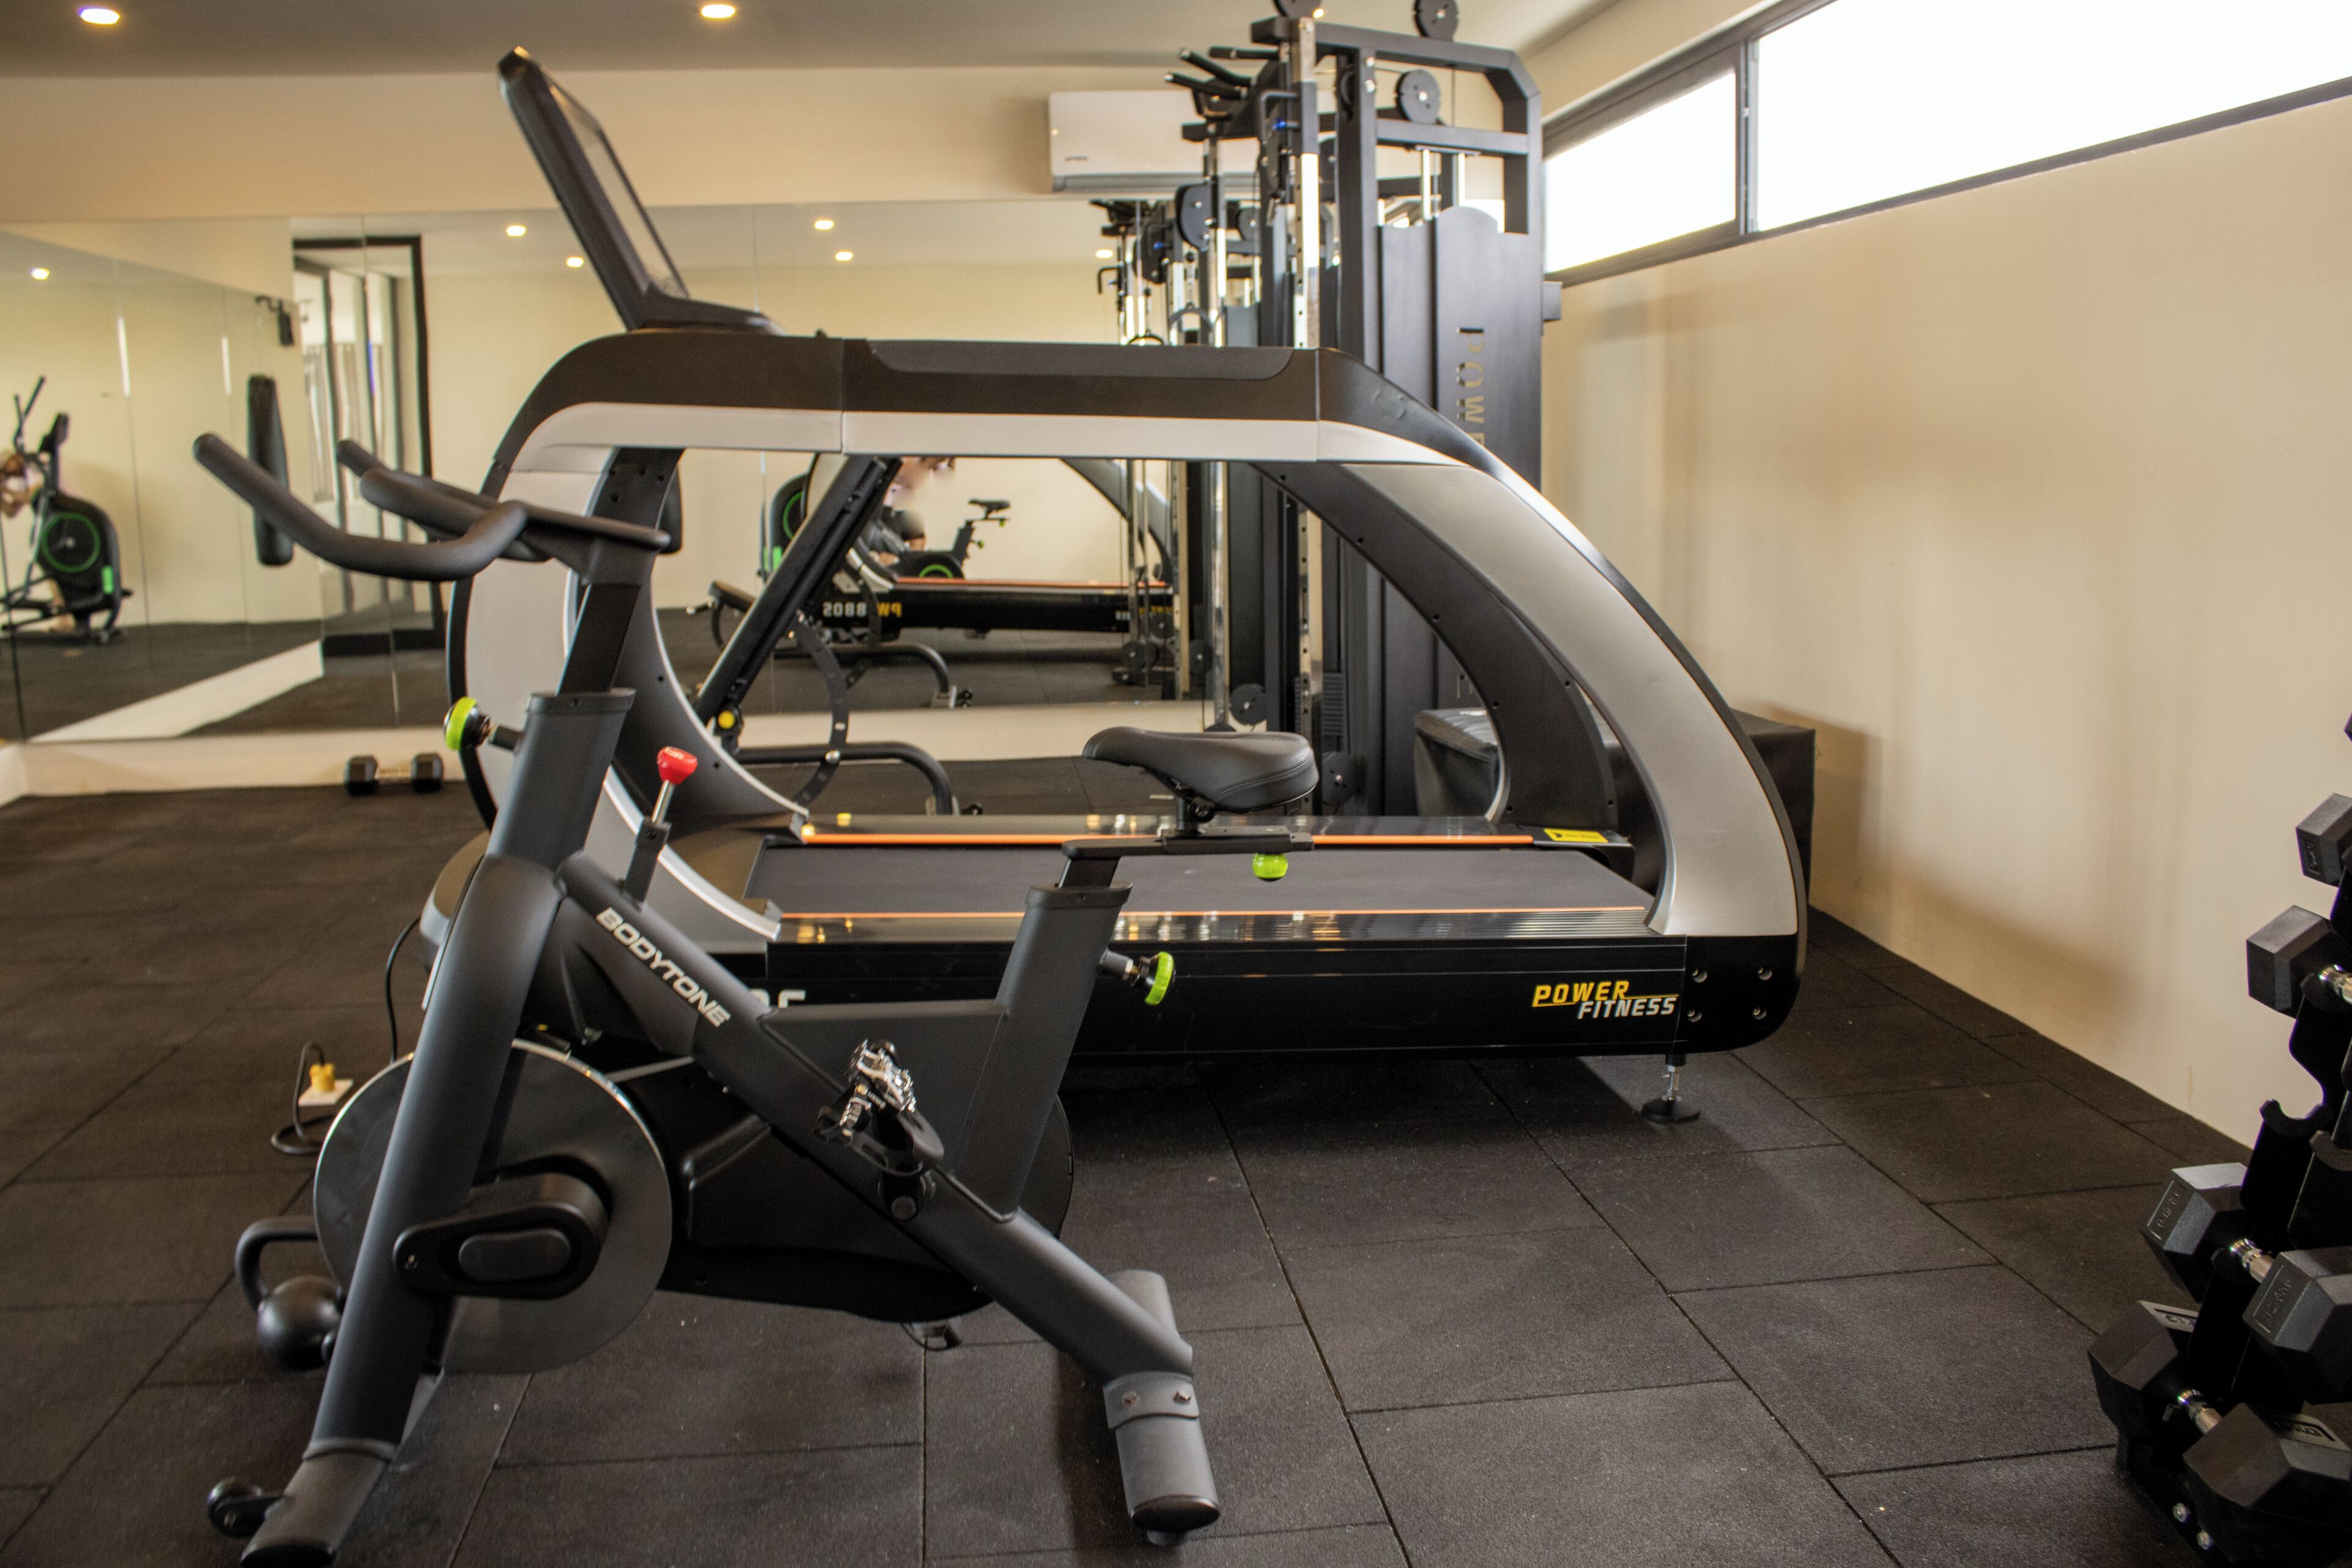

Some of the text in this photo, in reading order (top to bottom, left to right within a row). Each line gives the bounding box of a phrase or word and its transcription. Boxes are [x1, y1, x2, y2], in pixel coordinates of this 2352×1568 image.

[1455, 326, 1485, 446] POW
[596, 907, 731, 1027] BODYTONE
[1532, 981, 1629, 1007] POWER
[1577, 997, 1677, 1019] FITNESS
